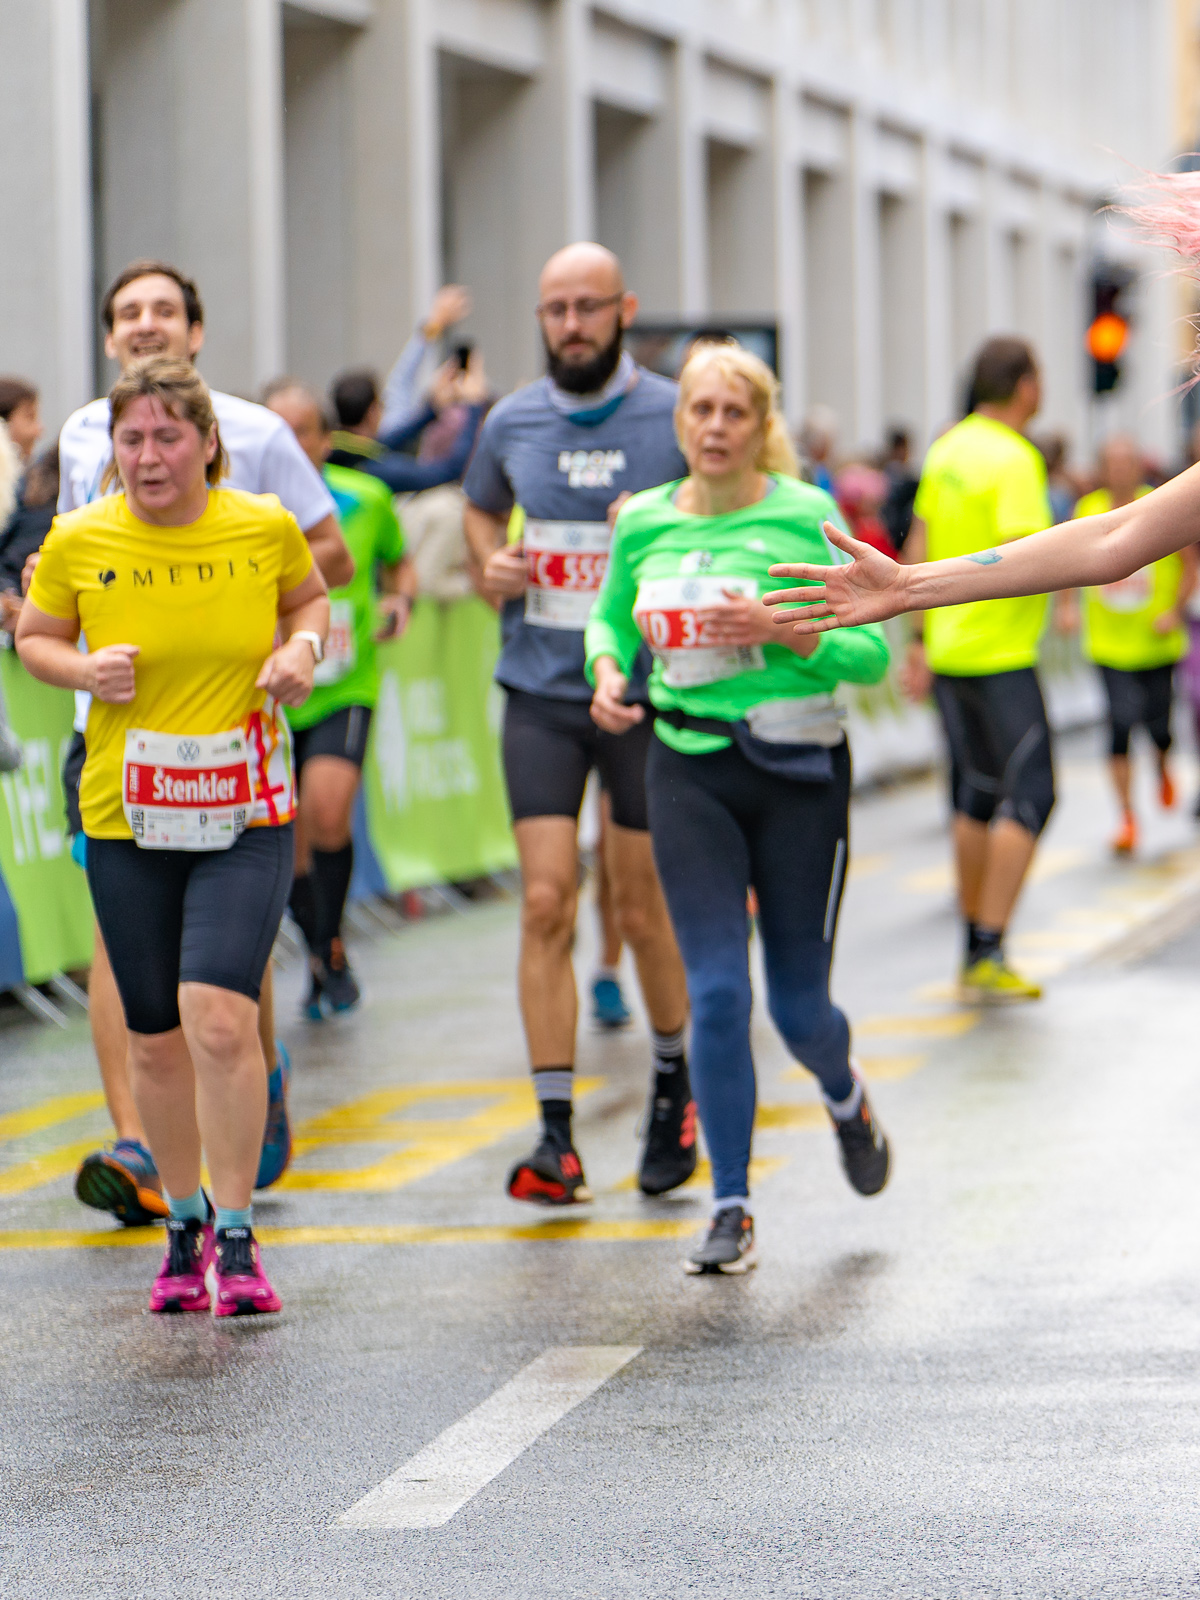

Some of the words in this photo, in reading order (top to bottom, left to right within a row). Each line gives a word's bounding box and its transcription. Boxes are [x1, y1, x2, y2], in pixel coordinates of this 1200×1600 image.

[132, 557, 259, 588] MEDIS
[649, 610, 670, 647] D
[152, 766, 238, 803] Štenkler
[199, 813, 208, 828] D
